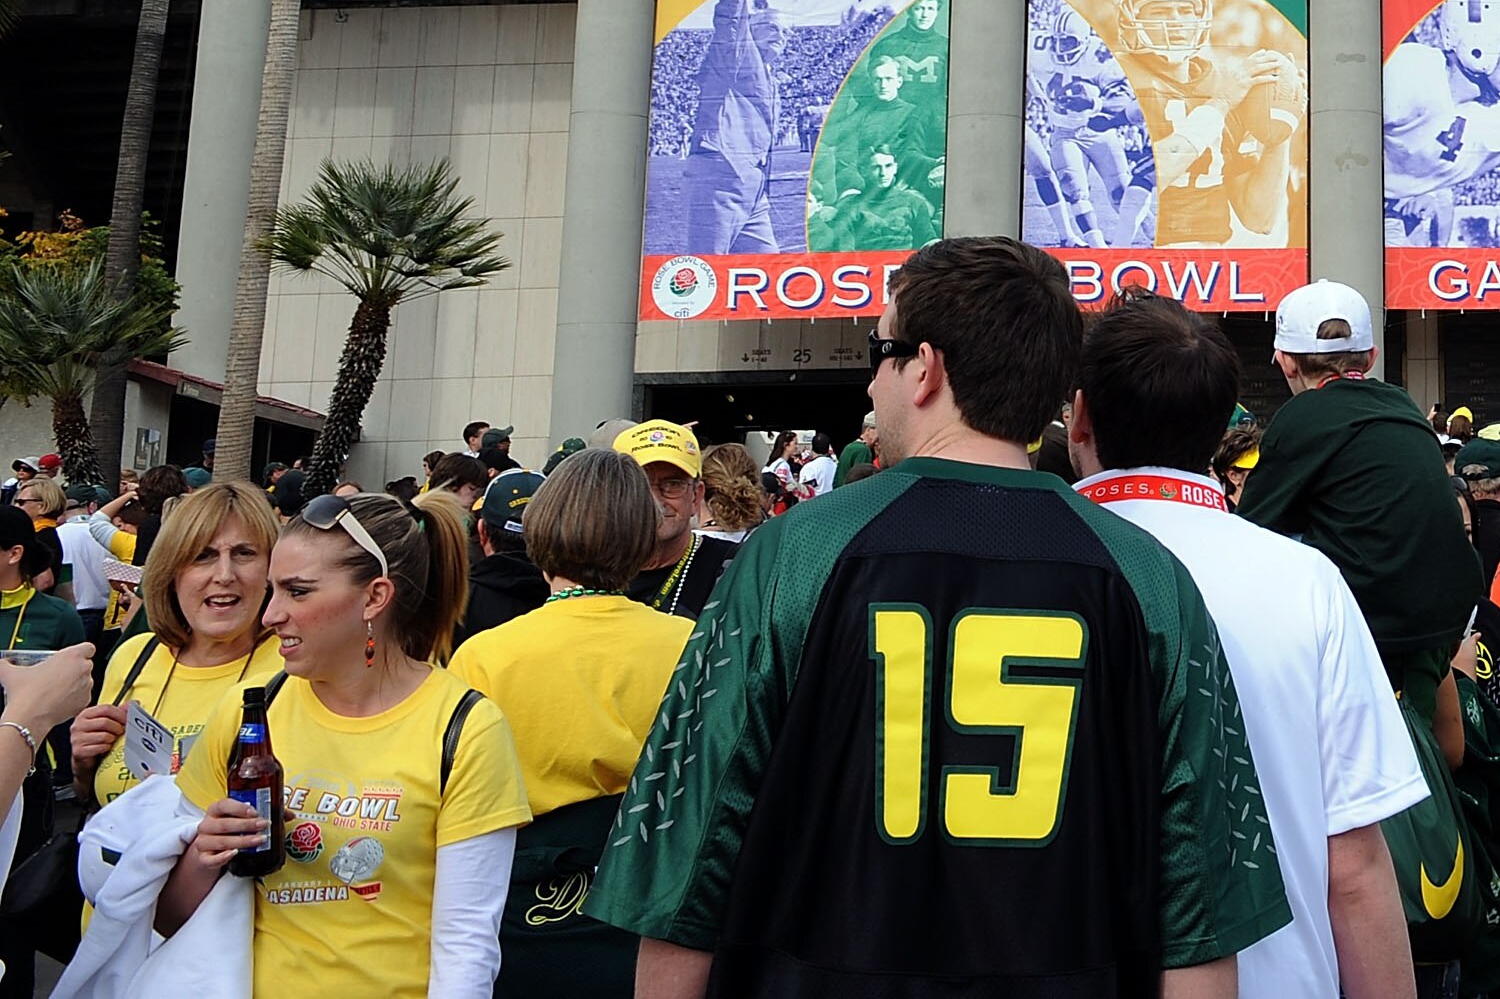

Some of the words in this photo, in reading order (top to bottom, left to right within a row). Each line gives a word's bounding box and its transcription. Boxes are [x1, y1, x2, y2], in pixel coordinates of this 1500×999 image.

[653, 265, 670, 290] ROSE
[670, 255, 700, 267] BOWL
[699, 262, 716, 289] GAME
[1064, 259, 1264, 303] BOWL
[674, 307, 690, 318] citi
[792, 348, 812, 364] 25
[631, 426, 681, 439] OREGON
[631, 443, 655, 453] ROSE
[1181, 484, 1222, 509] ROSE
[134, 716, 164, 744] citi
[867, 602, 1090, 849] 15
[316, 791, 402, 822] BOWL
[332, 816, 357, 829] OHIO
[360, 819, 392, 832] STATE
